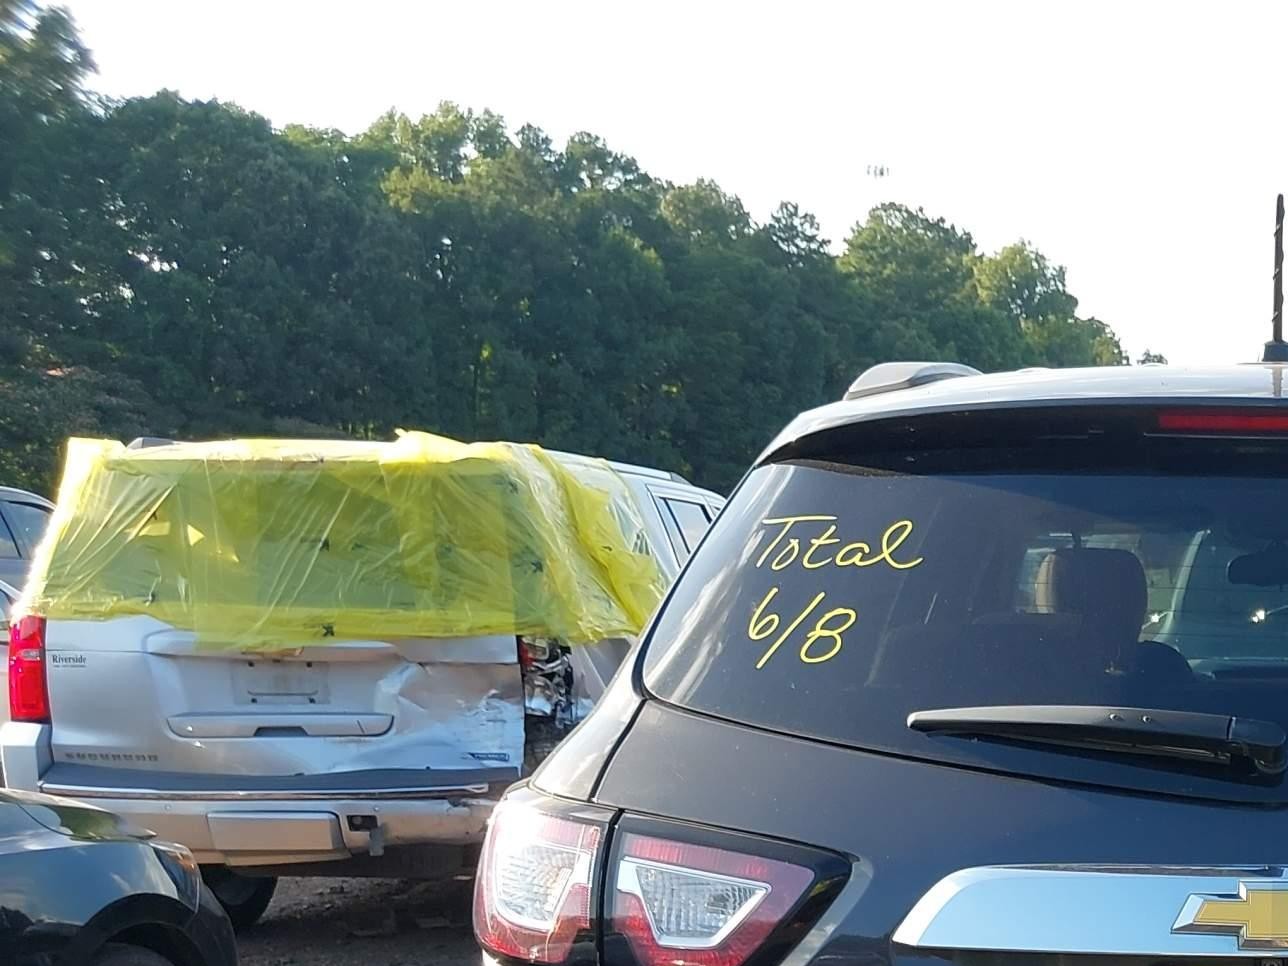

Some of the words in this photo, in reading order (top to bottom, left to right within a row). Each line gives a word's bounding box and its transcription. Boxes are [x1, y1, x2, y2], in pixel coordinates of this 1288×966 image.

[756, 515, 924, 571] Total
[748, 587, 857, 670] 6/8
[52, 653, 87, 664] Riverside
